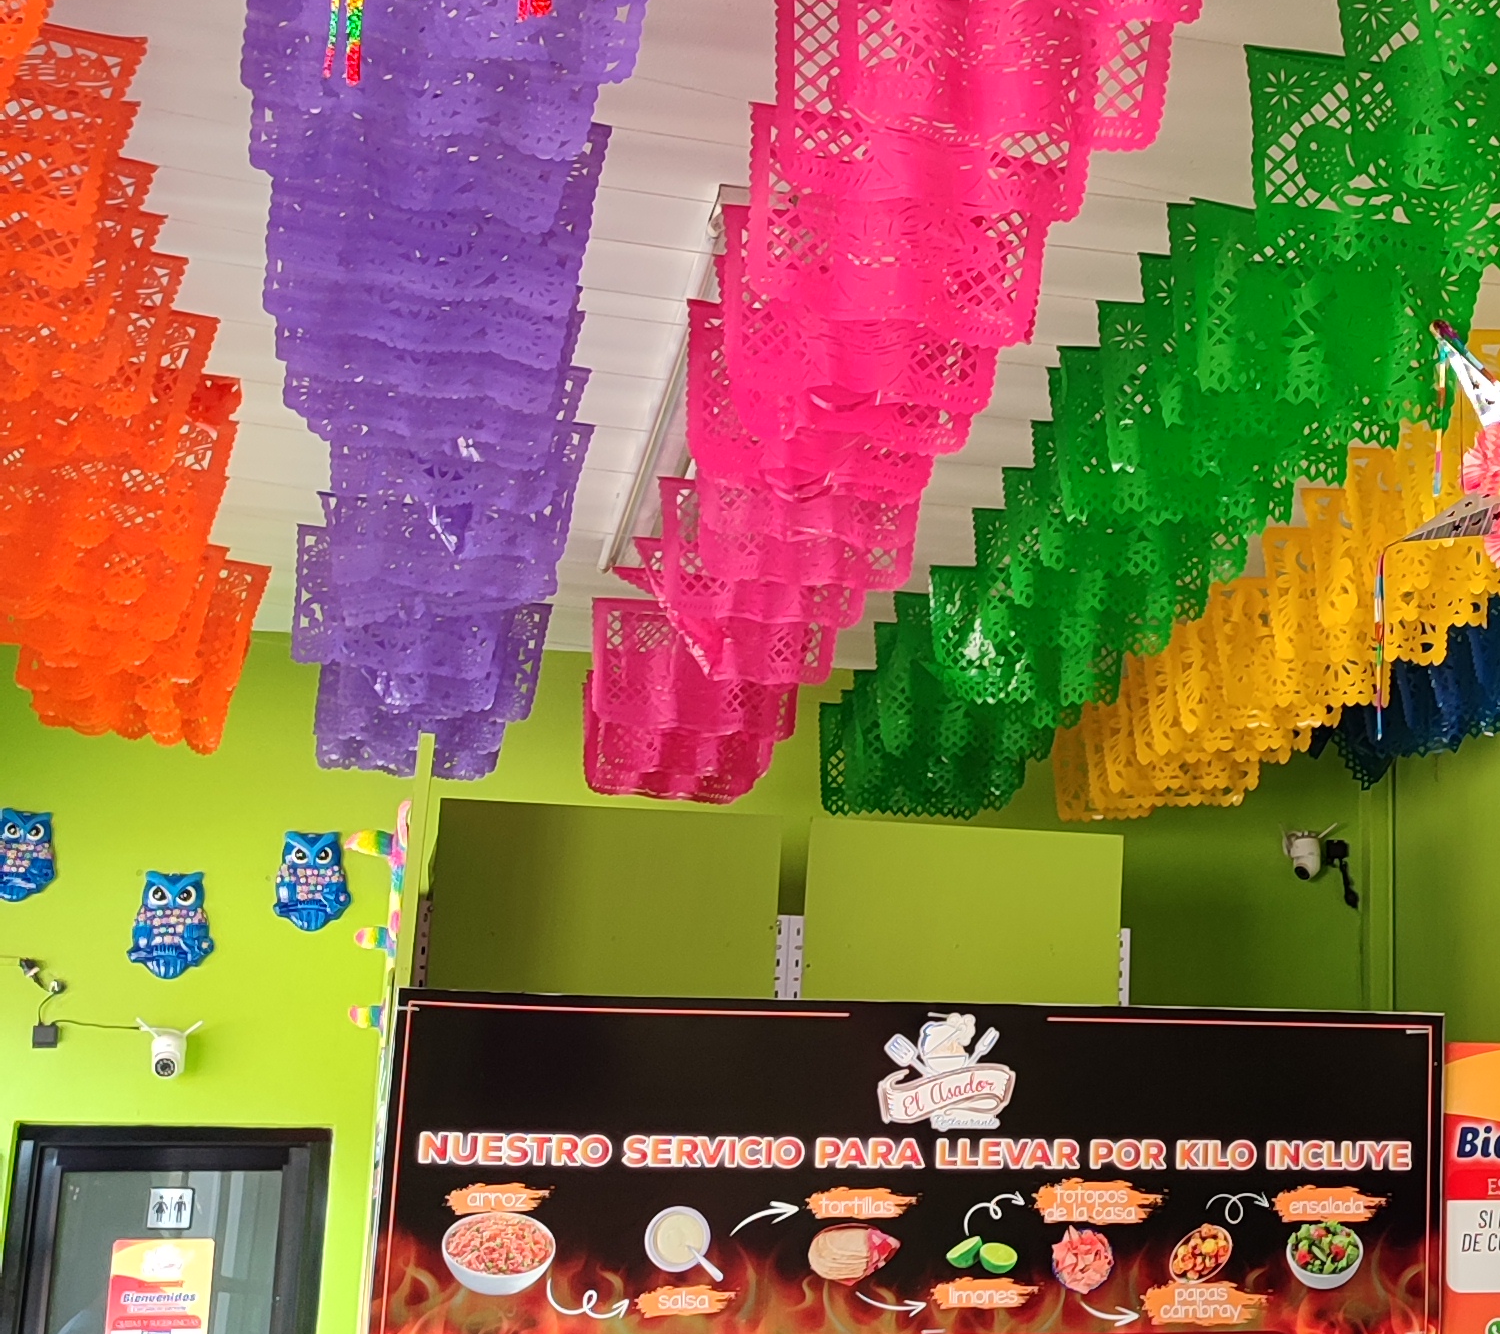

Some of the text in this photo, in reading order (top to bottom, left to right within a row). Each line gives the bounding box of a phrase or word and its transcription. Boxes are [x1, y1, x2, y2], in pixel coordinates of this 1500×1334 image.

[903, 1072, 995, 1117] El Asador
[418, 1131, 1412, 1171] NUESTRO SERVICIO PARA LLEVAR POR KILO INCLUYE
[466, 1192, 528, 1208] arroz
[819, 1194, 895, 1215] tortillas
[1055, 1185, 1128, 1209] totopos
[1289, 1197, 1364, 1216] ensalada
[1045, 1203, 1136, 1221] de la casa
[1478, 1209, 1495, 1230] SI
[1461, 1233, 1484, 1253] DE
[123, 1292, 196, 1303] Bienvenidos
[657, 1291, 709, 1310] salsa
[949, 1286, 1018, 1306] limones
[1174, 1287, 1228, 1307] papas
[1160, 1300, 1242, 1321] cambray
